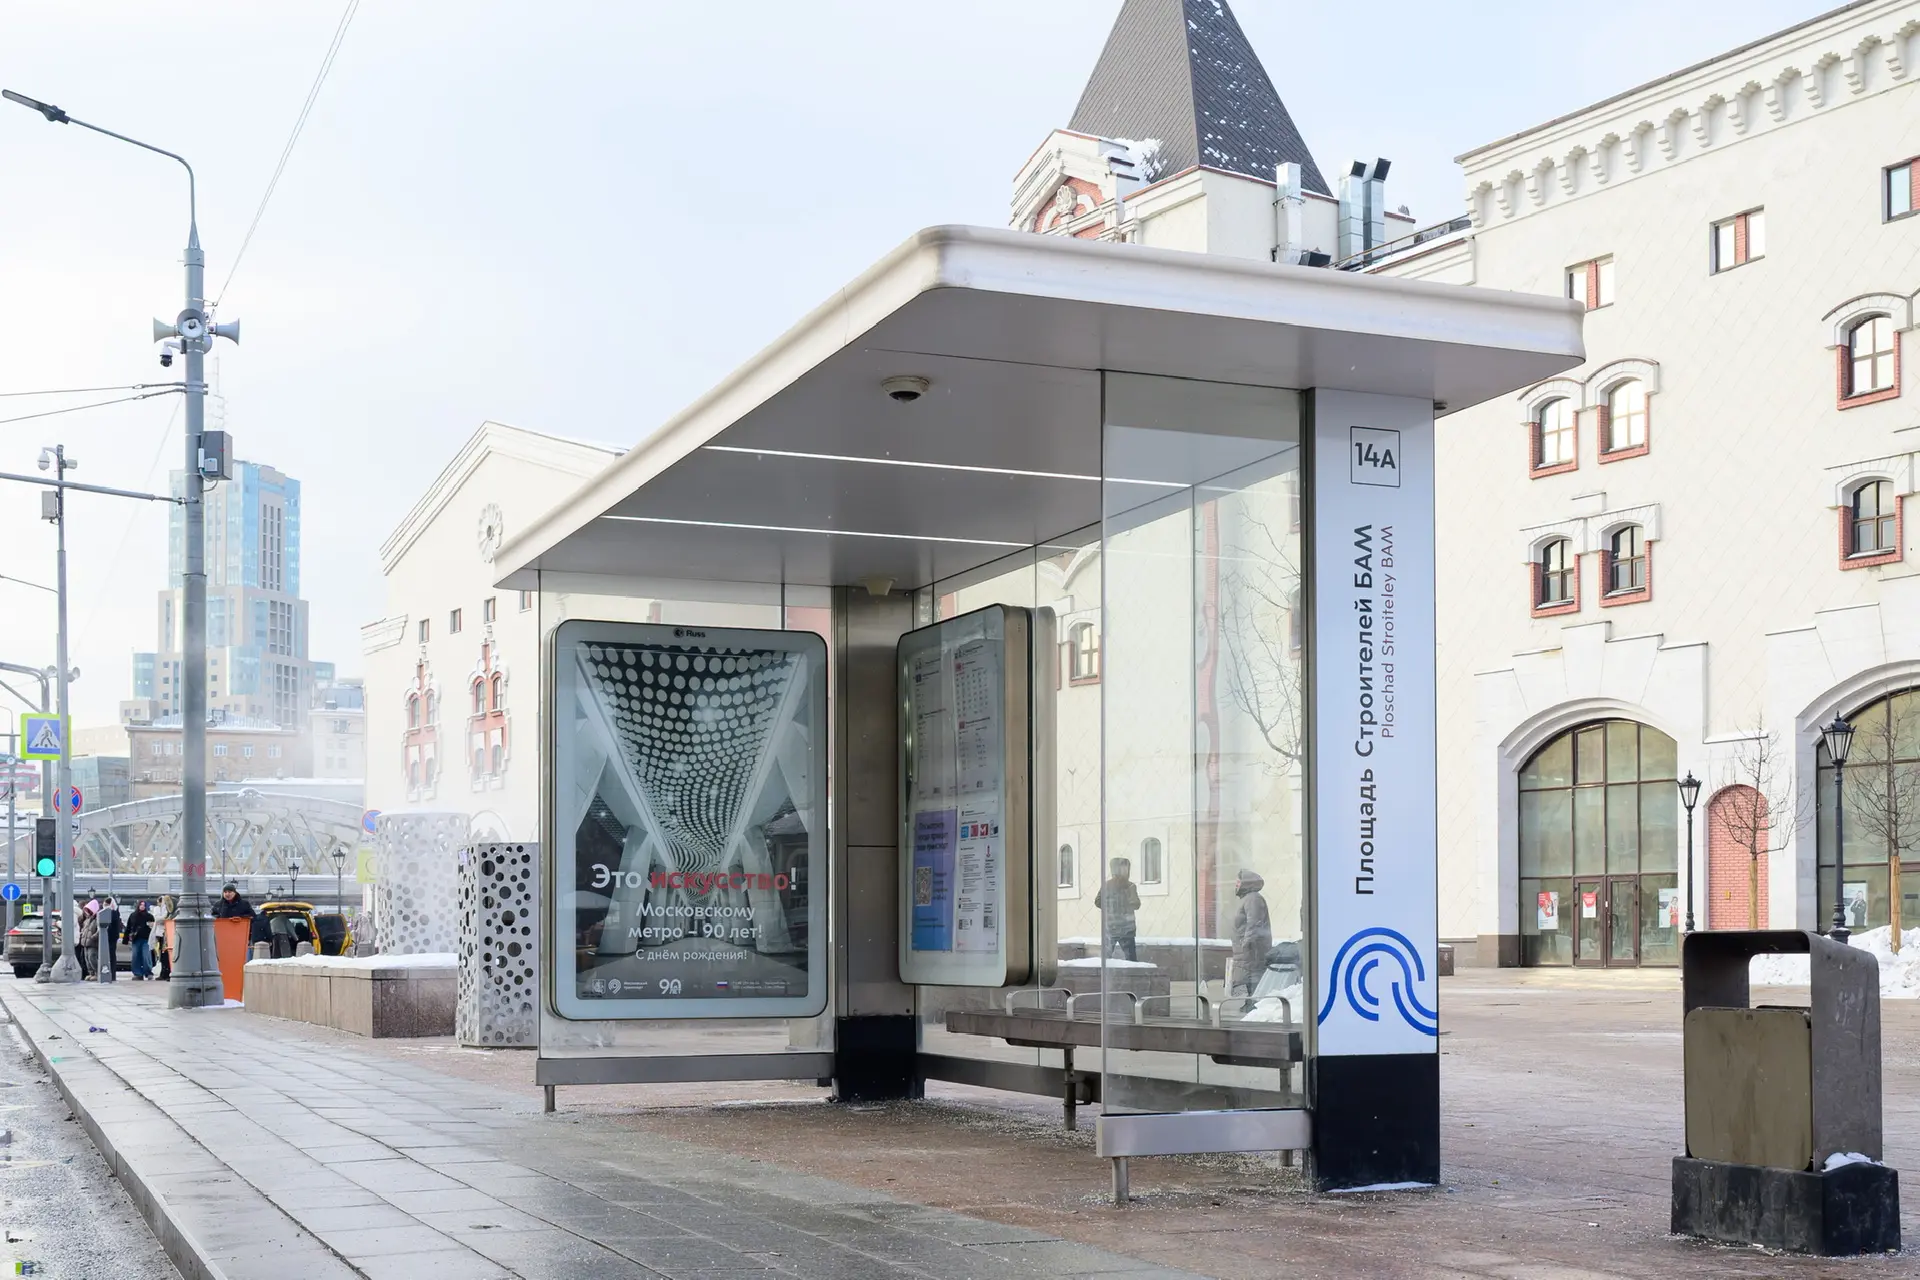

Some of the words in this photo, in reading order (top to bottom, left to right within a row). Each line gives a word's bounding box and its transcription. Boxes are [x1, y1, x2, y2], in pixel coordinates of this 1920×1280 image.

[1353, 524, 1372, 589] БАМ
[1380, 525, 1394, 568] BAM
[685, 629, 706, 638] Russ
[1380, 573, 1396, 657] Stroiteley
[1354, 598, 1378, 758] Строителей
[1381, 662, 1394, 739] Ploschad
[1355, 767, 1377, 895] Площадь
[591, 863, 642, 889] Это
[650, 867, 797, 895] искусство!
[628, 926, 683, 941] метро
[702, 922, 725, 939] 90
[729, 924, 762, 939] лет!
[635, 902, 755, 921] Московскому
[648, 949, 680, 961] днём
[683, 949, 748, 961] рождения!
